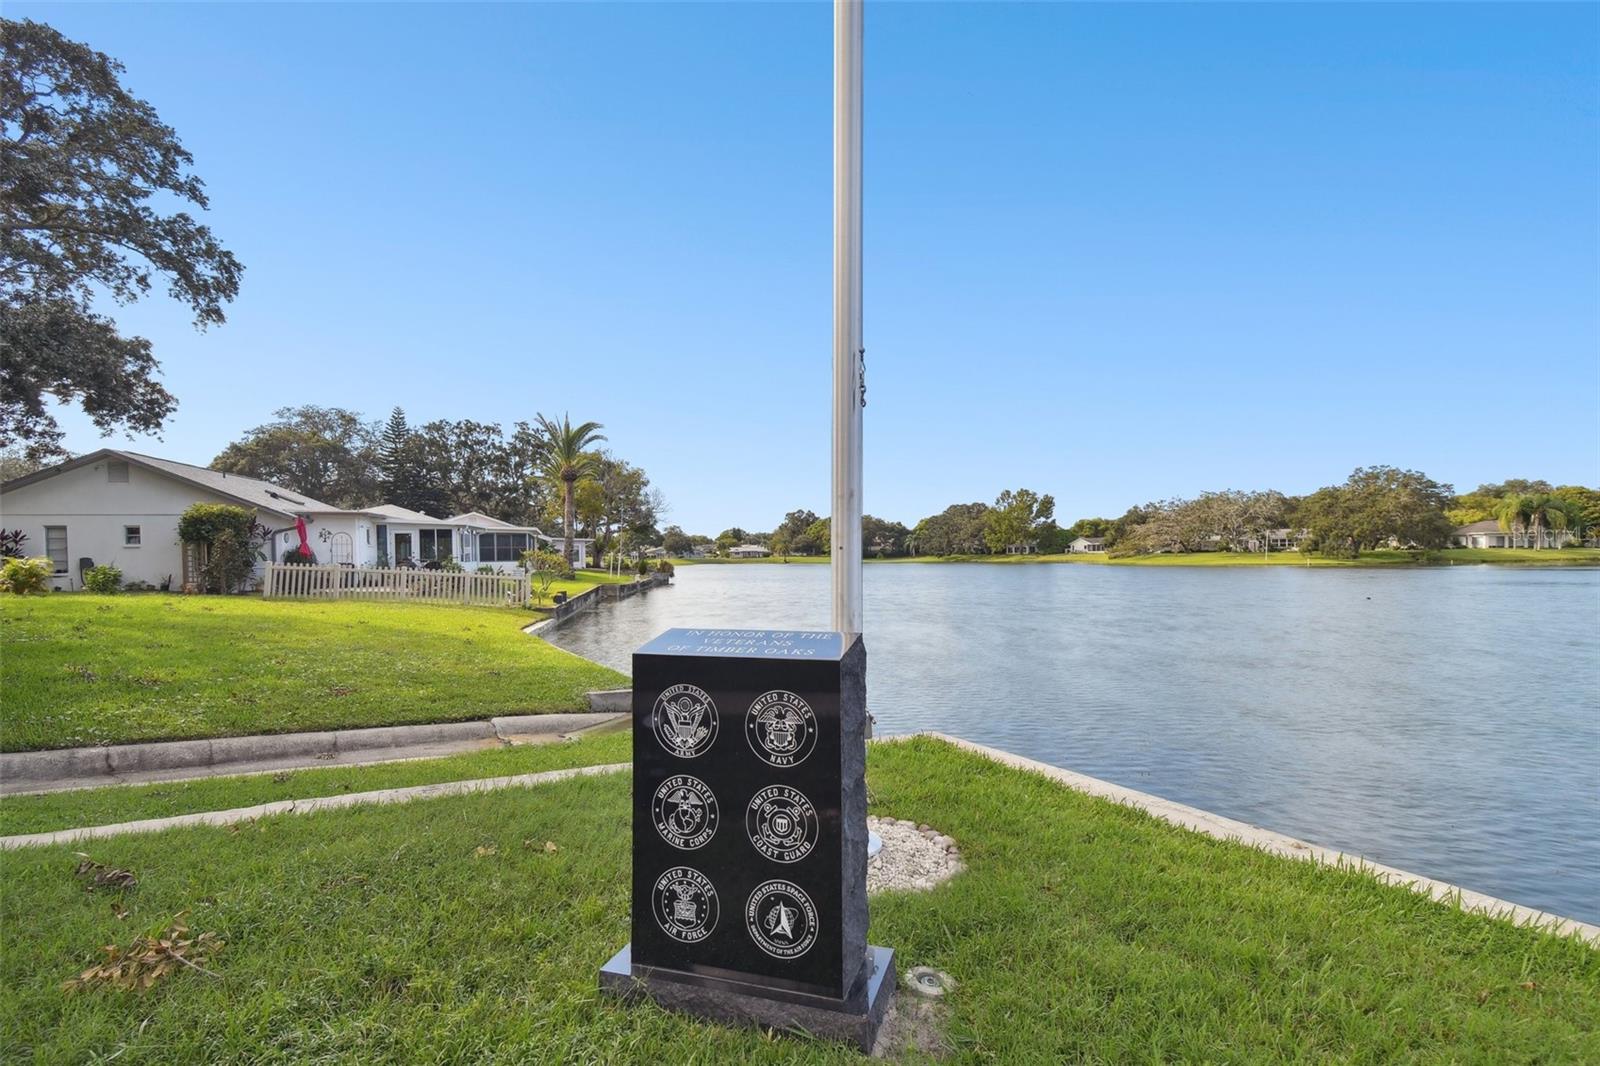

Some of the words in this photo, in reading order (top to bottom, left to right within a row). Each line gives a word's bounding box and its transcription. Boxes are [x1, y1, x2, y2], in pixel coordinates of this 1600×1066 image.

[702, 638, 794, 647] VETERANS
[707, 630, 766, 639] HONOR
[800, 632, 833, 640] THE
[667, 645, 688, 653] OF
[696, 646, 758, 654] TIMBER
[763, 647, 816, 656] OAKS
[660, 685, 684, 701] UNITED
[688, 685, 711, 704] STATES
[751, 693, 779, 716] UNITED
[783, 693, 812, 719] STATES
[674, 749, 696, 758] ARMY
[769, 754, 794, 765] NAVY
[657, 778, 683, 799] UNITED
[687, 778, 714, 804] STATES
[751, 788, 779, 810] UNITED
[783, 788, 813, 817] STATES
[658, 822, 685, 847] MARINE
[689, 828, 713, 847] CORPS
[753, 834, 779, 859] COAST
[783, 841, 811, 861] GUARD
[657, 869, 683, 891] UNITED
[687, 870, 714, 897] STATES
[748, 890, 763, 917] UNITED
[761, 883, 786, 895] STATES
[786, 885, 806, 904] SPACE
[803, 902, 816, 927] FORCE
[663, 922, 678, 936] AIR
[681, 926, 708, 940] FORCE
